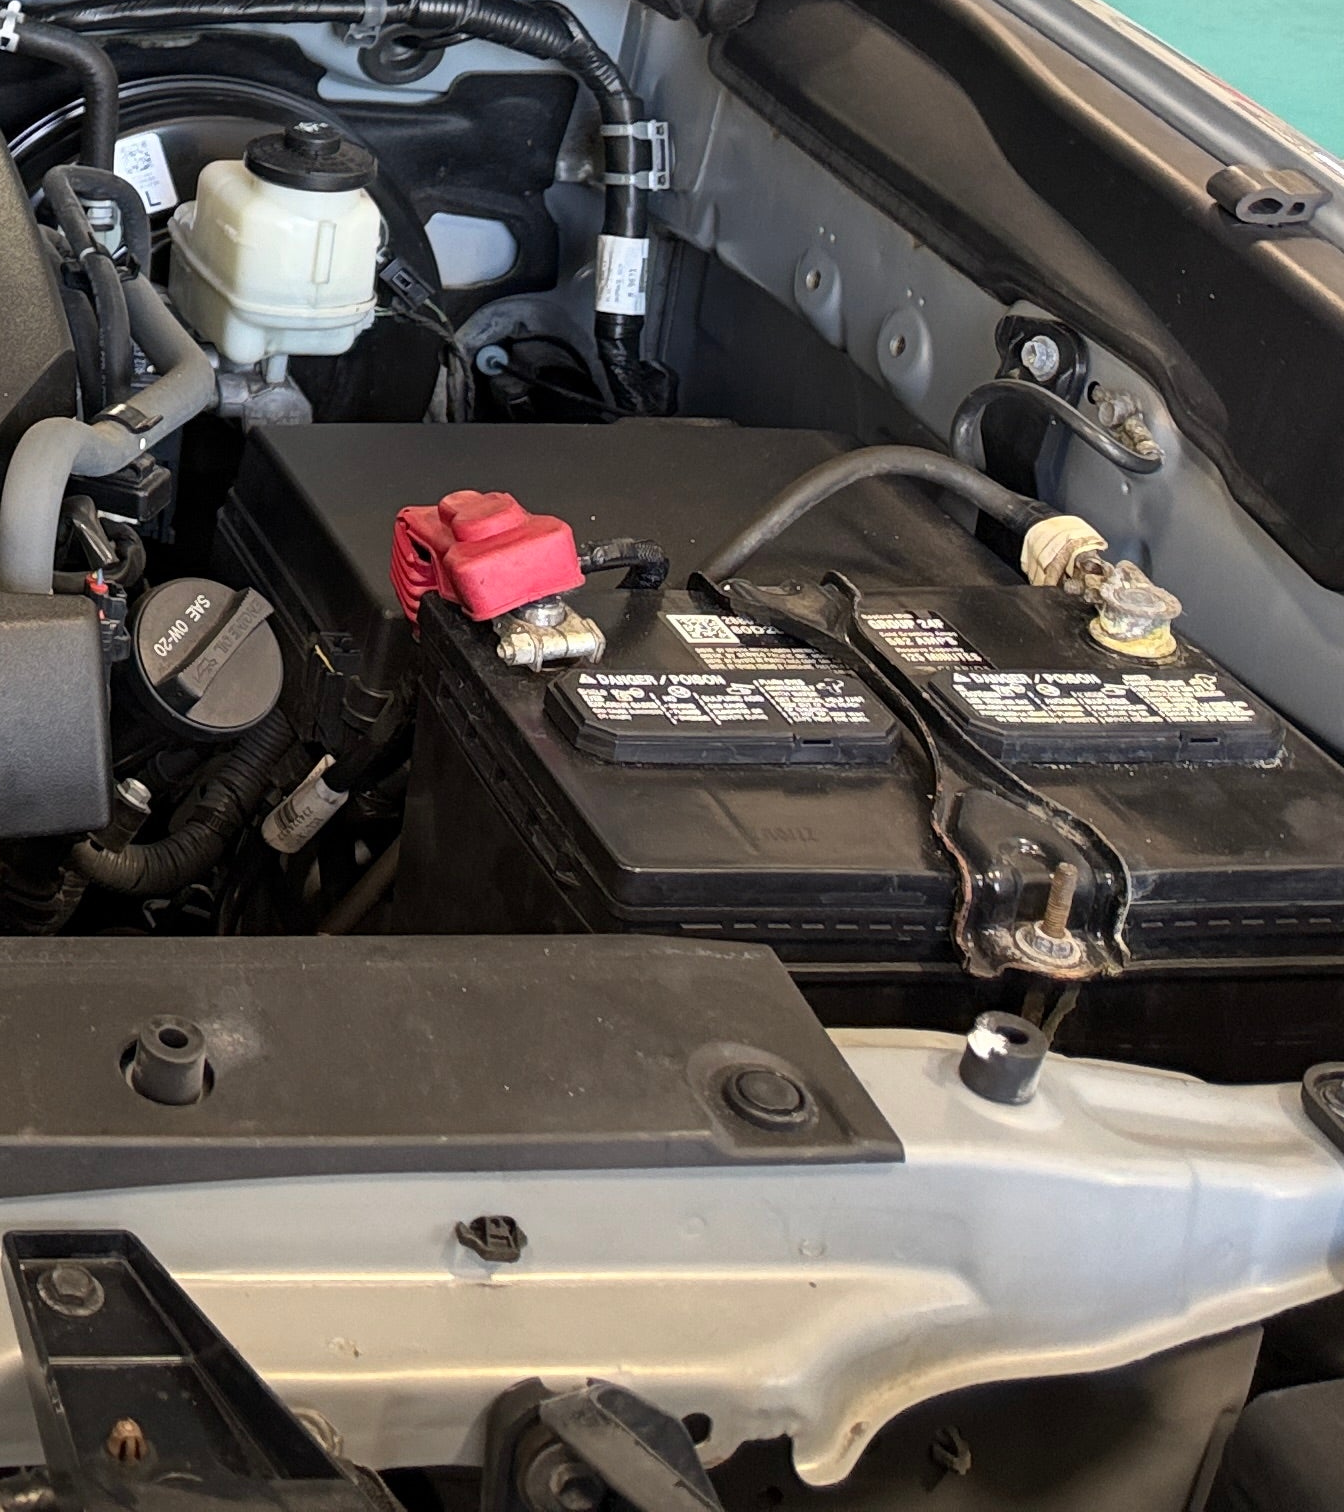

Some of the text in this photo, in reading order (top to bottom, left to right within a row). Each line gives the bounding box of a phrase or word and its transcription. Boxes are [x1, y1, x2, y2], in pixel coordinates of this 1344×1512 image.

[153, 593, 211, 658] SAE 0W-20
[867, 619, 915, 629] GROUP
[915, 636, 958, 646] AMPS
[923, 652, 983, 662] MINUTES
[596, 674, 659, 686] DANGER
[667, 674, 727, 686] POISON
[968, 672, 1032, 684] DANGER
[1041, 673, 1103, 685] POISON
